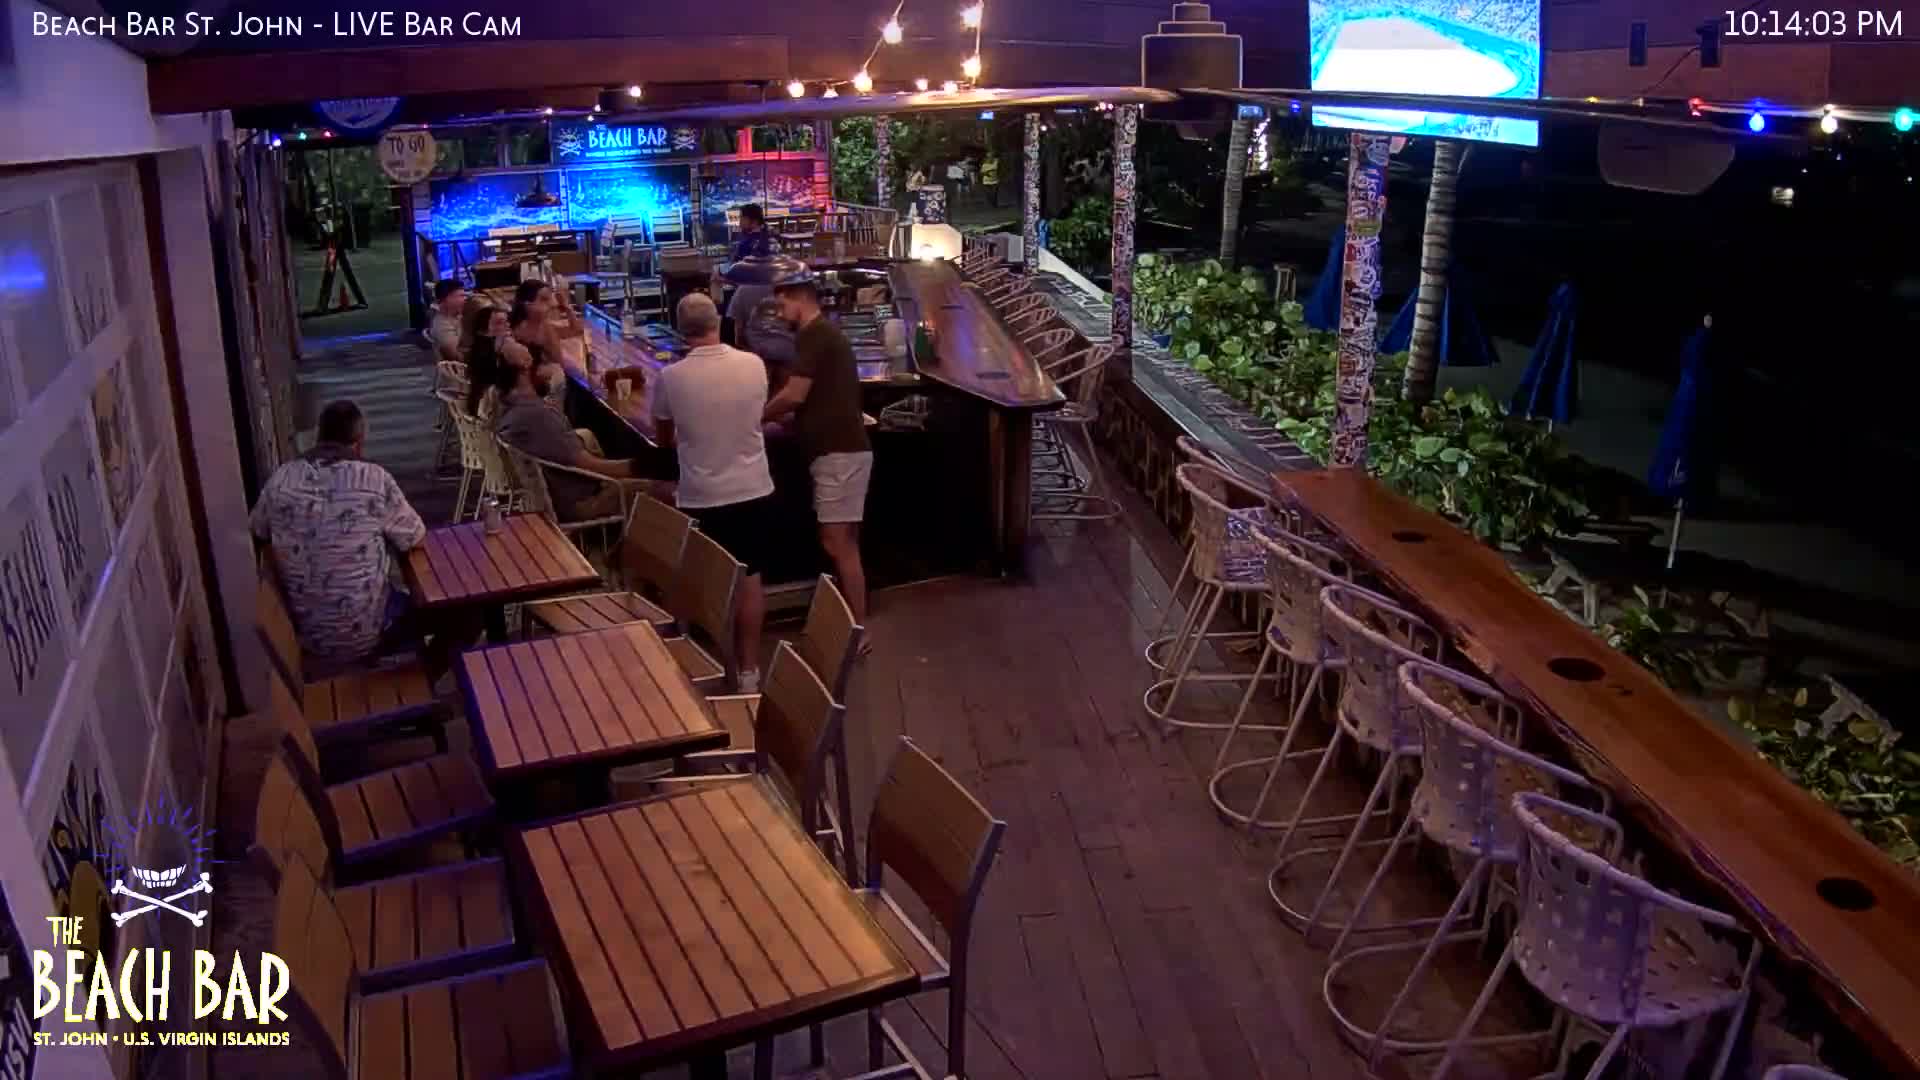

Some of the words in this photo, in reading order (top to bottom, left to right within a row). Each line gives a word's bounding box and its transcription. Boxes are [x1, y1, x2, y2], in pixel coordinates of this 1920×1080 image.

[386, 136, 404, 154] TO
[408, 135, 425, 153] GO
[588, 127, 632, 149] BEACH
[637, 126, 668, 146] BAR
